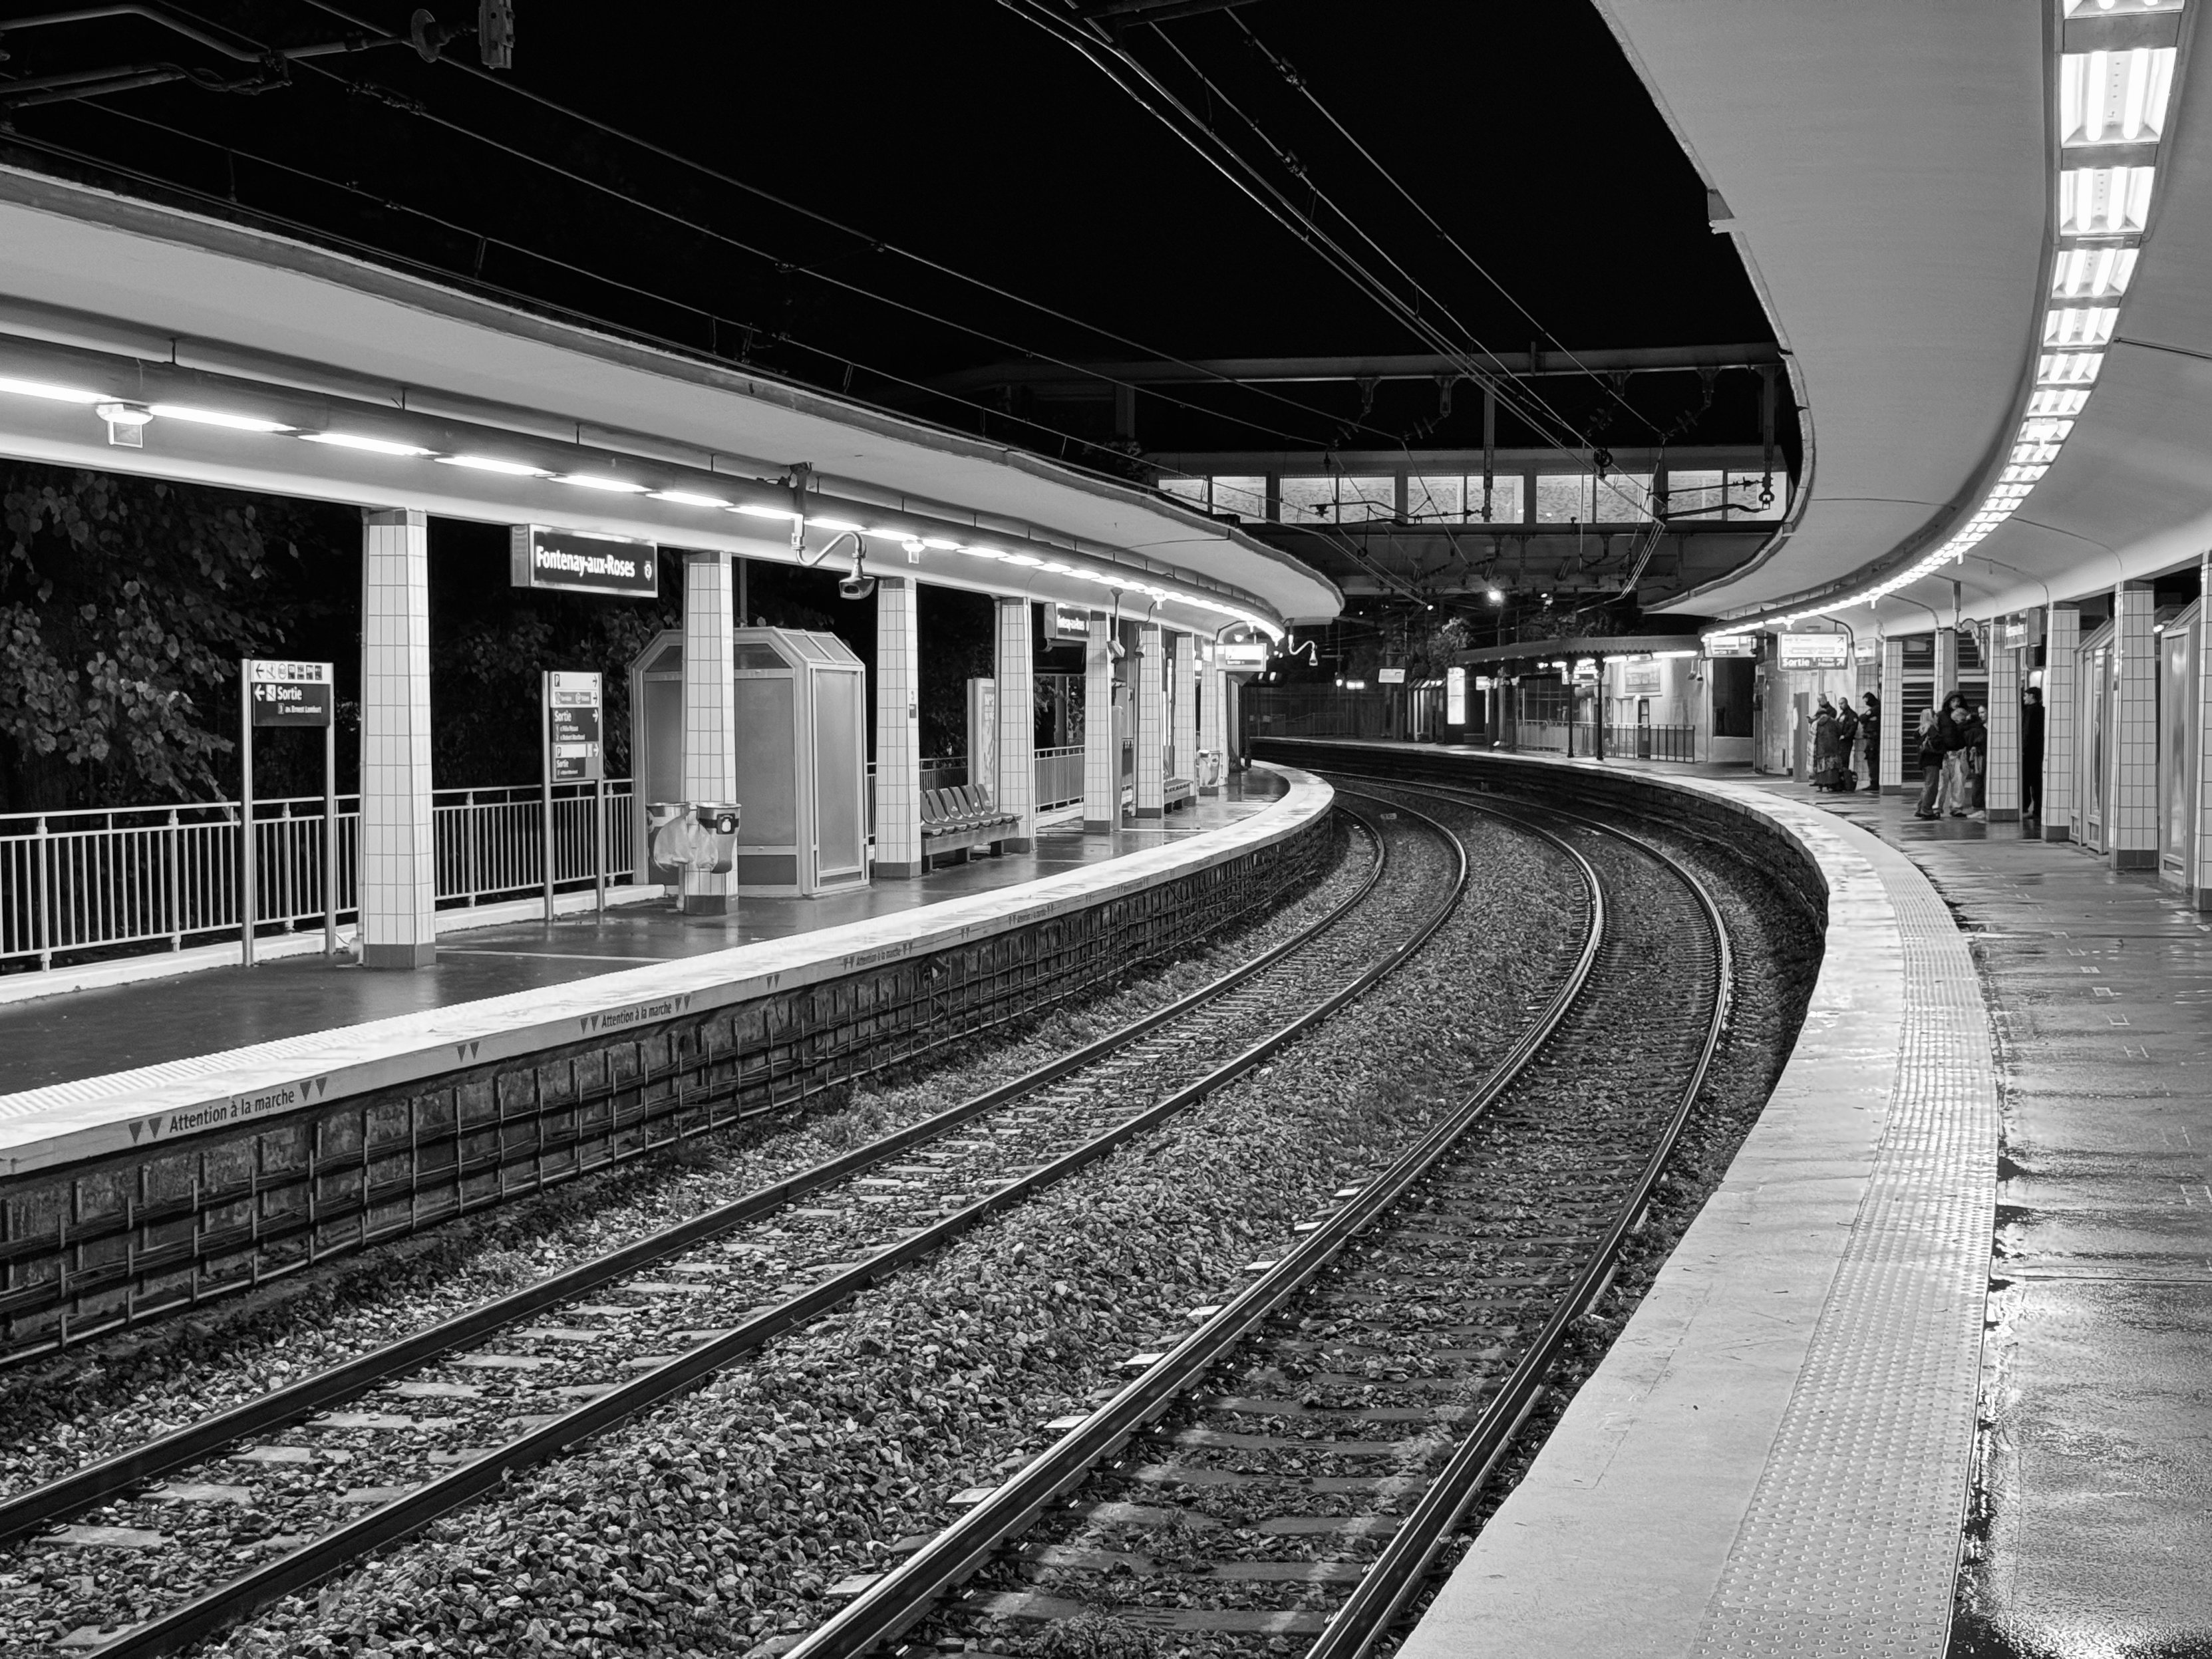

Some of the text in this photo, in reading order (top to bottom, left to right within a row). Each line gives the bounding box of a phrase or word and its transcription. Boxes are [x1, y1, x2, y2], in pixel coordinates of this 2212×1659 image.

[536, 545, 635, 577] Fontenay-aux-Roses
[1782, 658, 1810, 667] Sortie
[277, 686, 302, 701] Sortie
[554, 709, 572, 722] Sortie
[601, 1001, 672, 1028] Attention à la marche
[169, 1089, 295, 1133] Attention à la marche
